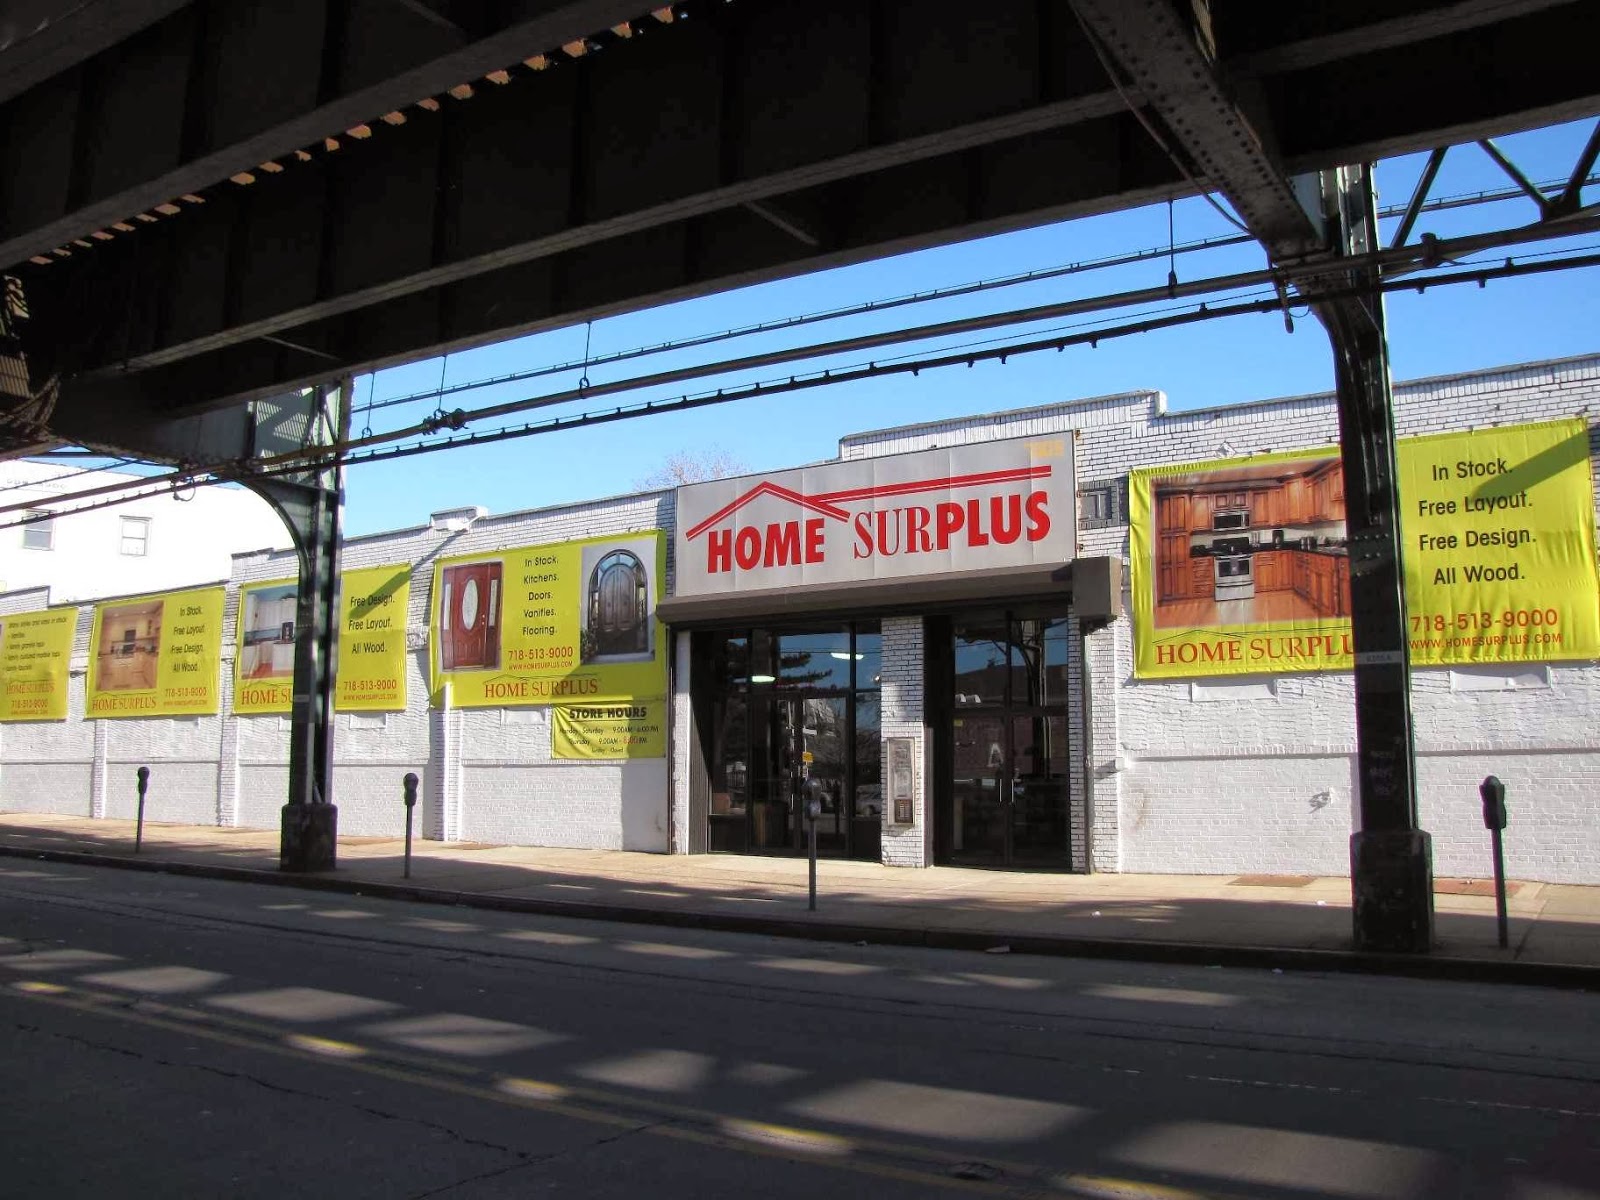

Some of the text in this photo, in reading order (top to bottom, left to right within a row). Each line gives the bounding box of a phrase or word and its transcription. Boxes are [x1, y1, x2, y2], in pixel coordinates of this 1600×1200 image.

[1432, 457, 1513, 481] In Stock.
[1418, 491, 1533, 517] Free Layout.
[707, 490, 1051, 574] HOME SURPLUS
[1419, 528, 1537, 551] Free Design.
[525, 558, 533, 567] In
[523, 572, 560, 585] Kitchens.
[1433, 562, 1525, 585] All Wood.
[350, 596, 365, 607] Free
[528, 591, 554, 601] Doors.
[349, 619, 364, 631] Free
[1410, 608, 1559, 633] 718-513-9000
[522, 625, 558, 637] Flooring.
[1408, 632, 1564, 650] WWW.HOMESURPLUS.COM
[352, 643, 361, 655] All
[508, 646, 573, 660] 718-513-9000
[1156, 634, 1354, 665] HOME SURPLU
[343, 679, 397, 691] 718-513-9000
[485, 678, 598, 698] HOME SURPLUS
[242, 689, 277, 705] HOME
[569, 707, 647, 719] STORE HOURS
